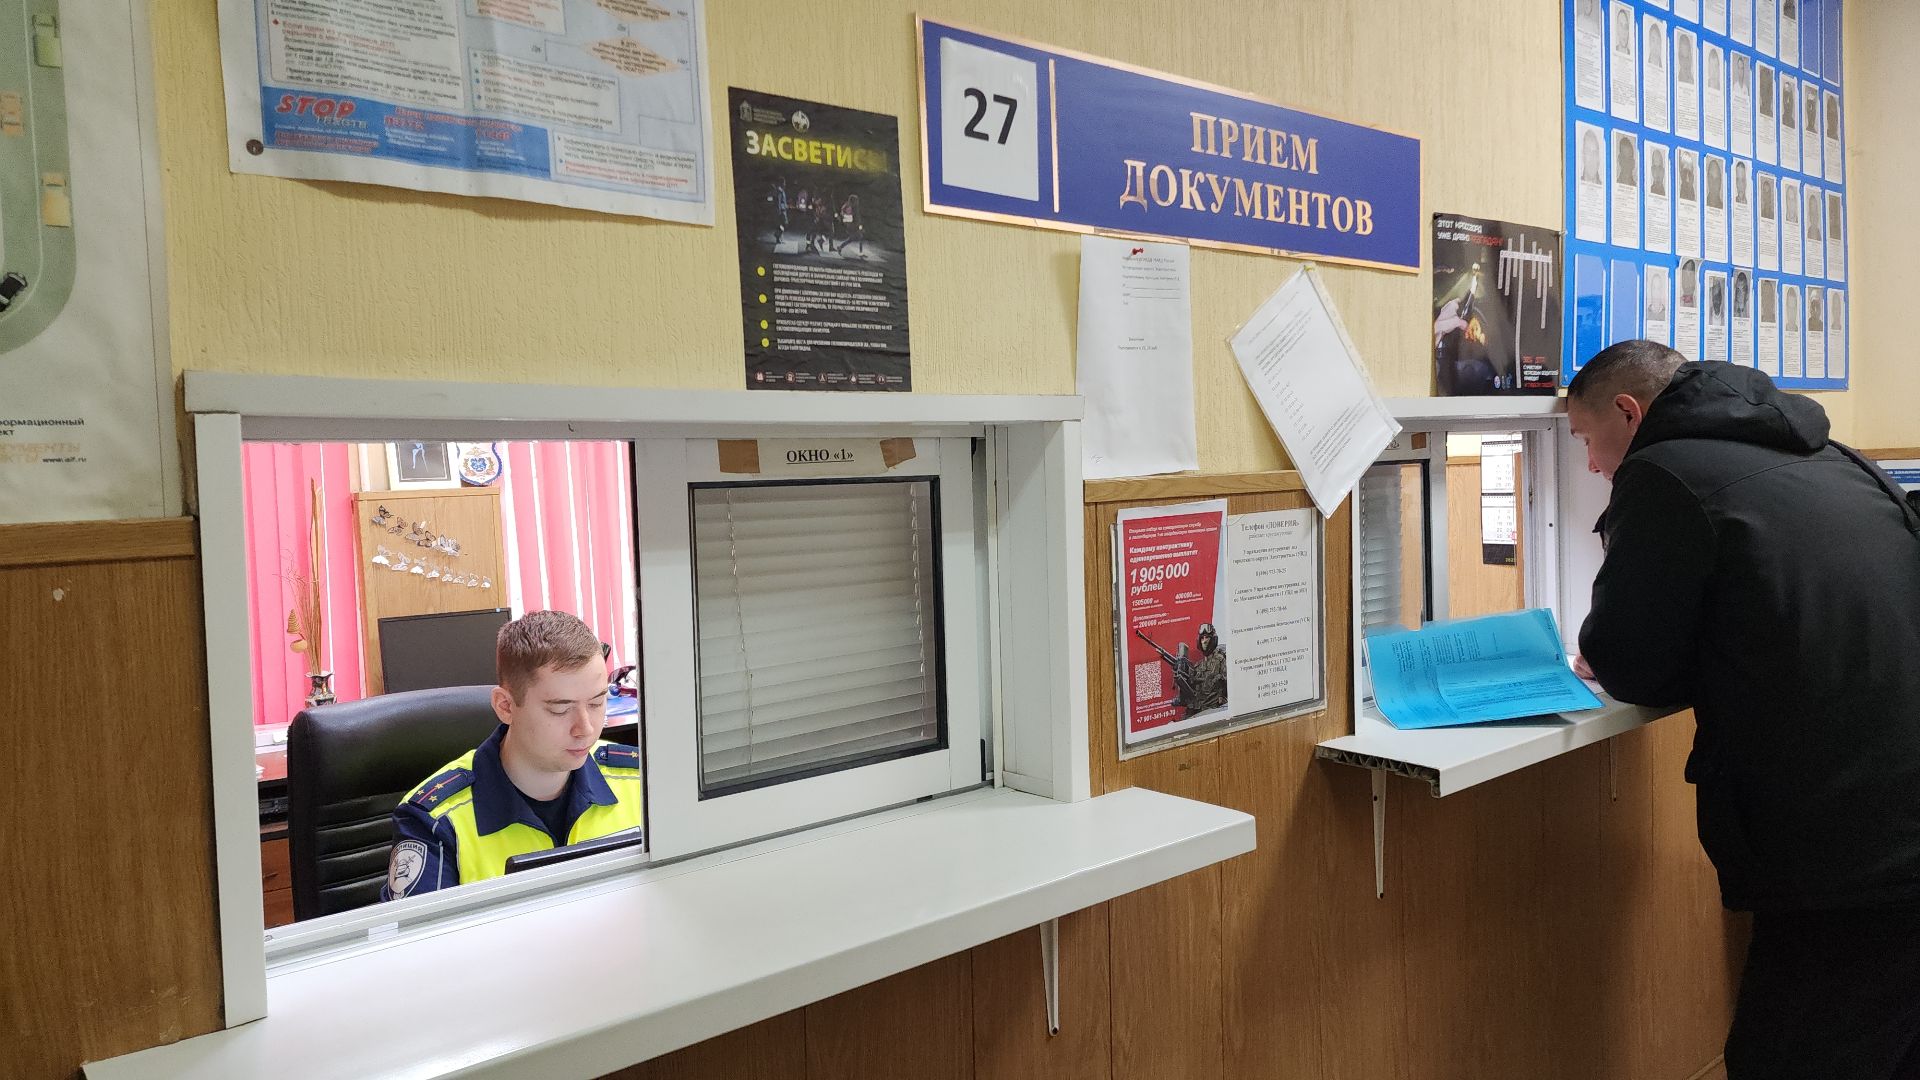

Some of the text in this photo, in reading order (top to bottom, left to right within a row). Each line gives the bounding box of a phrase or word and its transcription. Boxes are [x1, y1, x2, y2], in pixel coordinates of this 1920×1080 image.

[275, 94, 356, 119] STOP
[963, 87, 1018, 146] 27
[1189, 111, 1319, 175] ПРИЕМ
[1119, 159, 1374, 236] ДОКУМЕНТОВ
[1437, 220, 1454, 229] ЭТОТ
[786, 448, 854, 463] ОКНО «1»
[1130, 546, 1156, 554] Каждому
[1131, 581, 1163, 596] рублей
